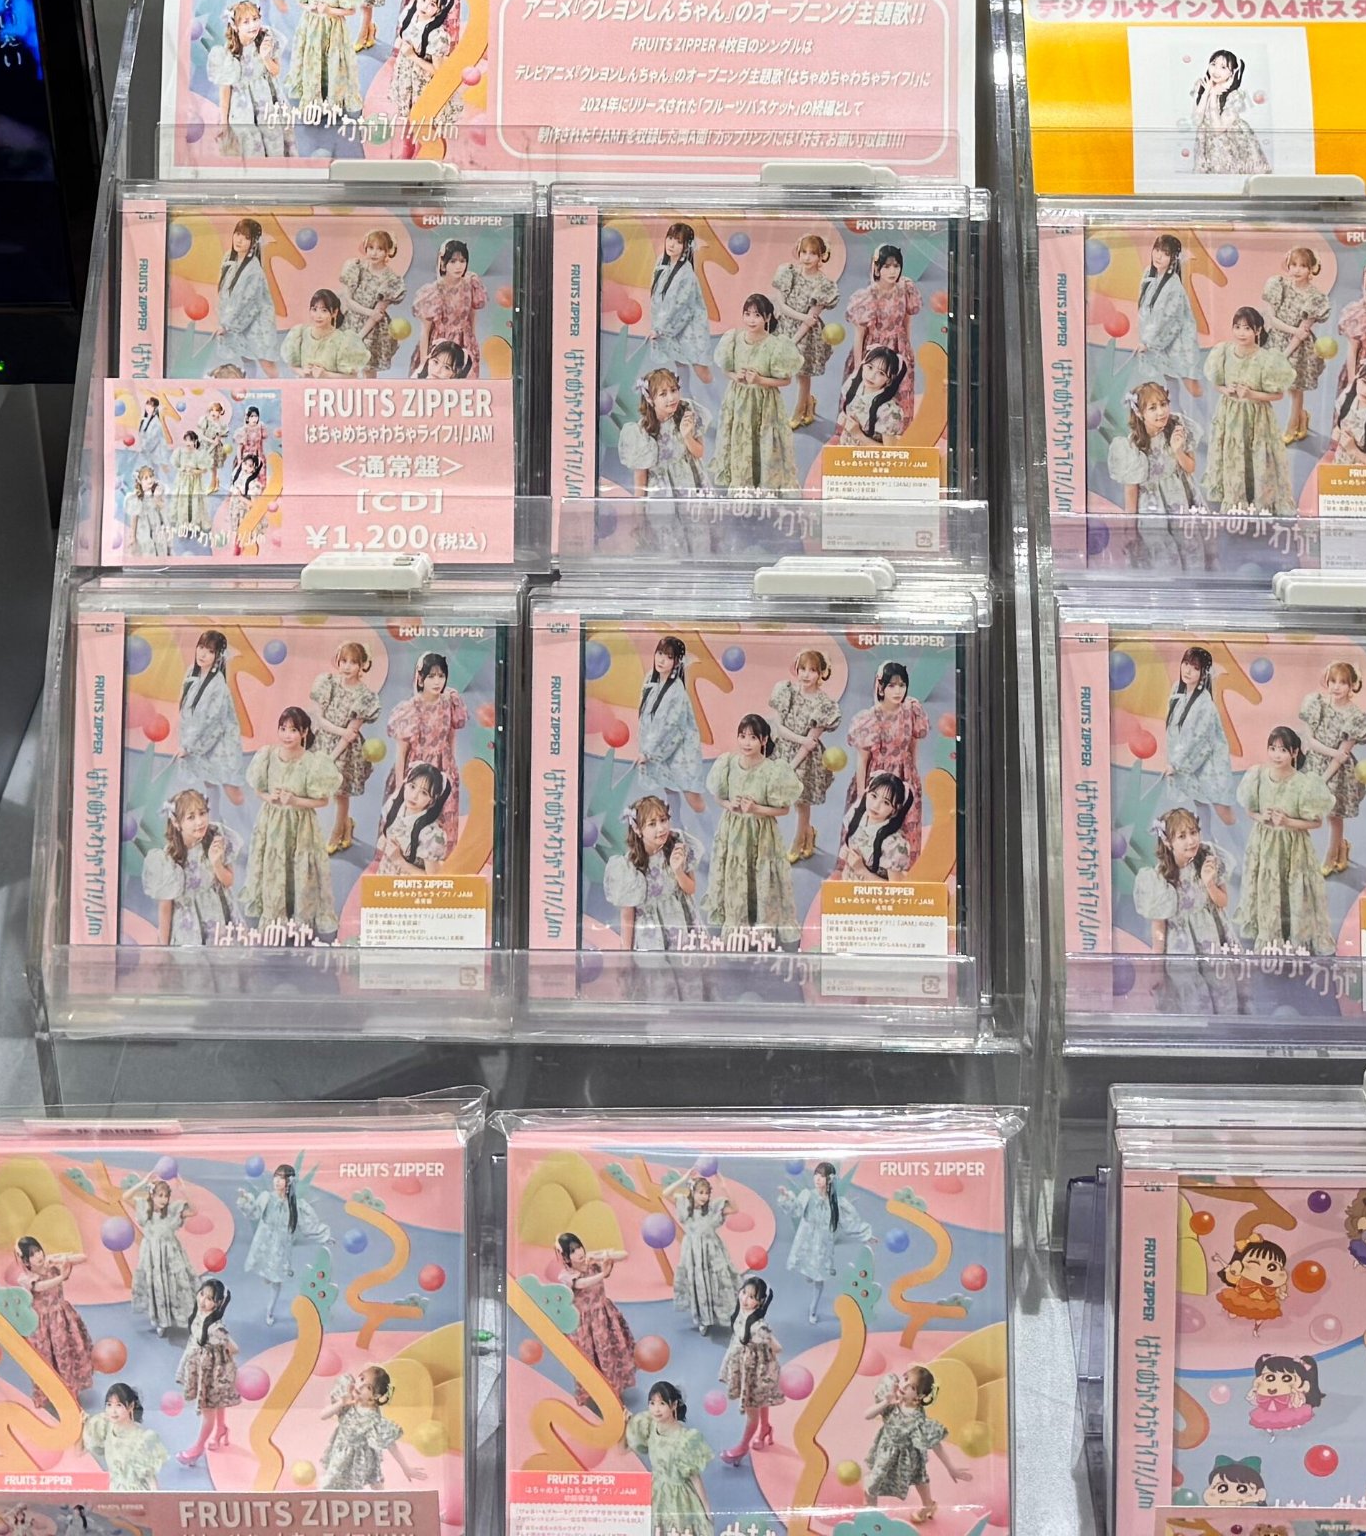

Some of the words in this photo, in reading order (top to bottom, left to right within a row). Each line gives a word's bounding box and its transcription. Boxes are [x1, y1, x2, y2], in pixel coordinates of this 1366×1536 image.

[631, 37, 671, 52] FRUITS
[674, 38, 716, 53] ZIPPER
[719, 38, 813, 55] 4枚目のシングルは
[423, 216, 461, 226] FRUITS
[464, 216, 502, 226] ZIPPER
[856, 219, 894, 231] FRUITS
[897, 220, 936, 231] ZIPPER
[304, 388, 395, 417] FRUITS
[402, 389, 492, 417] ZIPPER
[305, 425, 494, 445] はちゃめちゃわちゃライフ!/JAM
[356, 489, 443, 514] [CD]
[858, 634, 899, 647] FRUITS
[902, 634, 944, 647] ZIPPER
[339, 1163, 389, 1177] FRUITS
[393, 1163, 445, 1177] ZIPPER
[879, 1162, 930, 1177] FRUITS
[934, 1162, 985, 1177] ZIPPER
[178, 1501, 291, 1528] FRUITS
[300, 1500, 414, 1528] ZIPPER
